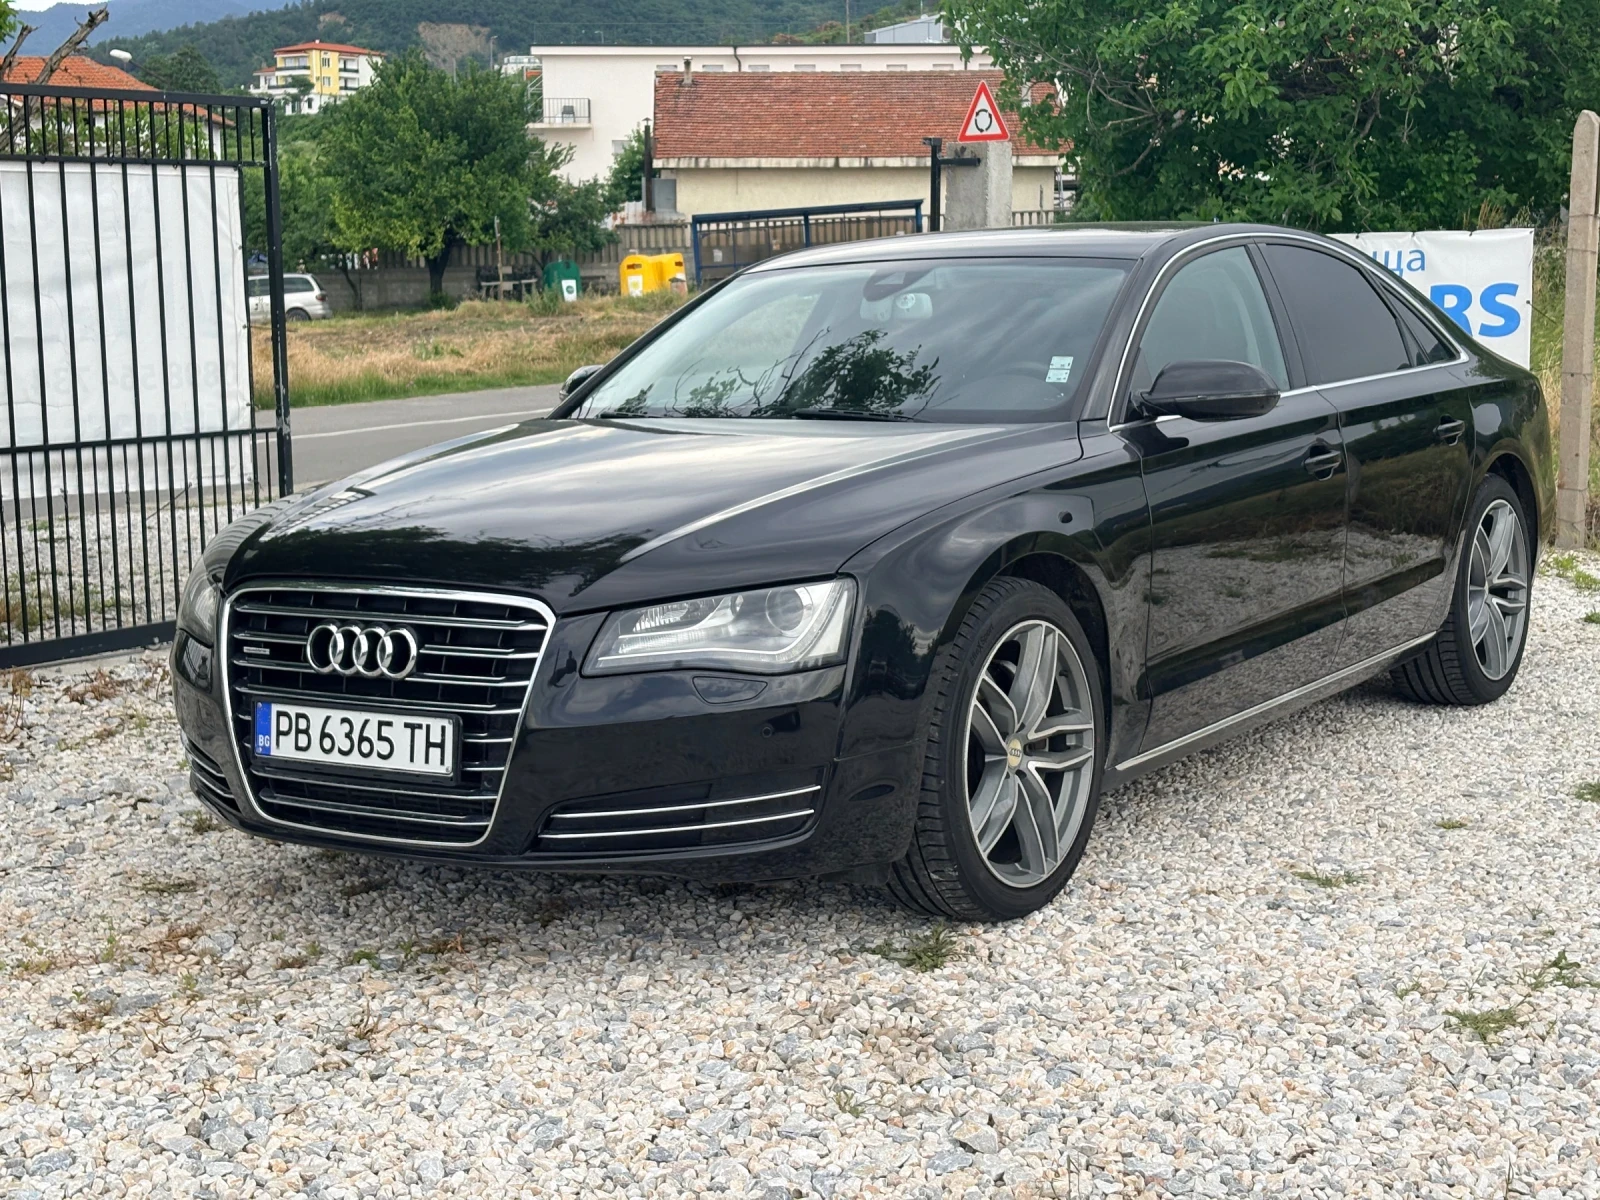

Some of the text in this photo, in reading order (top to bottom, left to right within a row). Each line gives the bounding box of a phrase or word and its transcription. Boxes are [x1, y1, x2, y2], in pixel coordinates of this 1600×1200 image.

[258, 734, 271, 747] BG
[275, 710, 447, 766] PB 6365 TH
